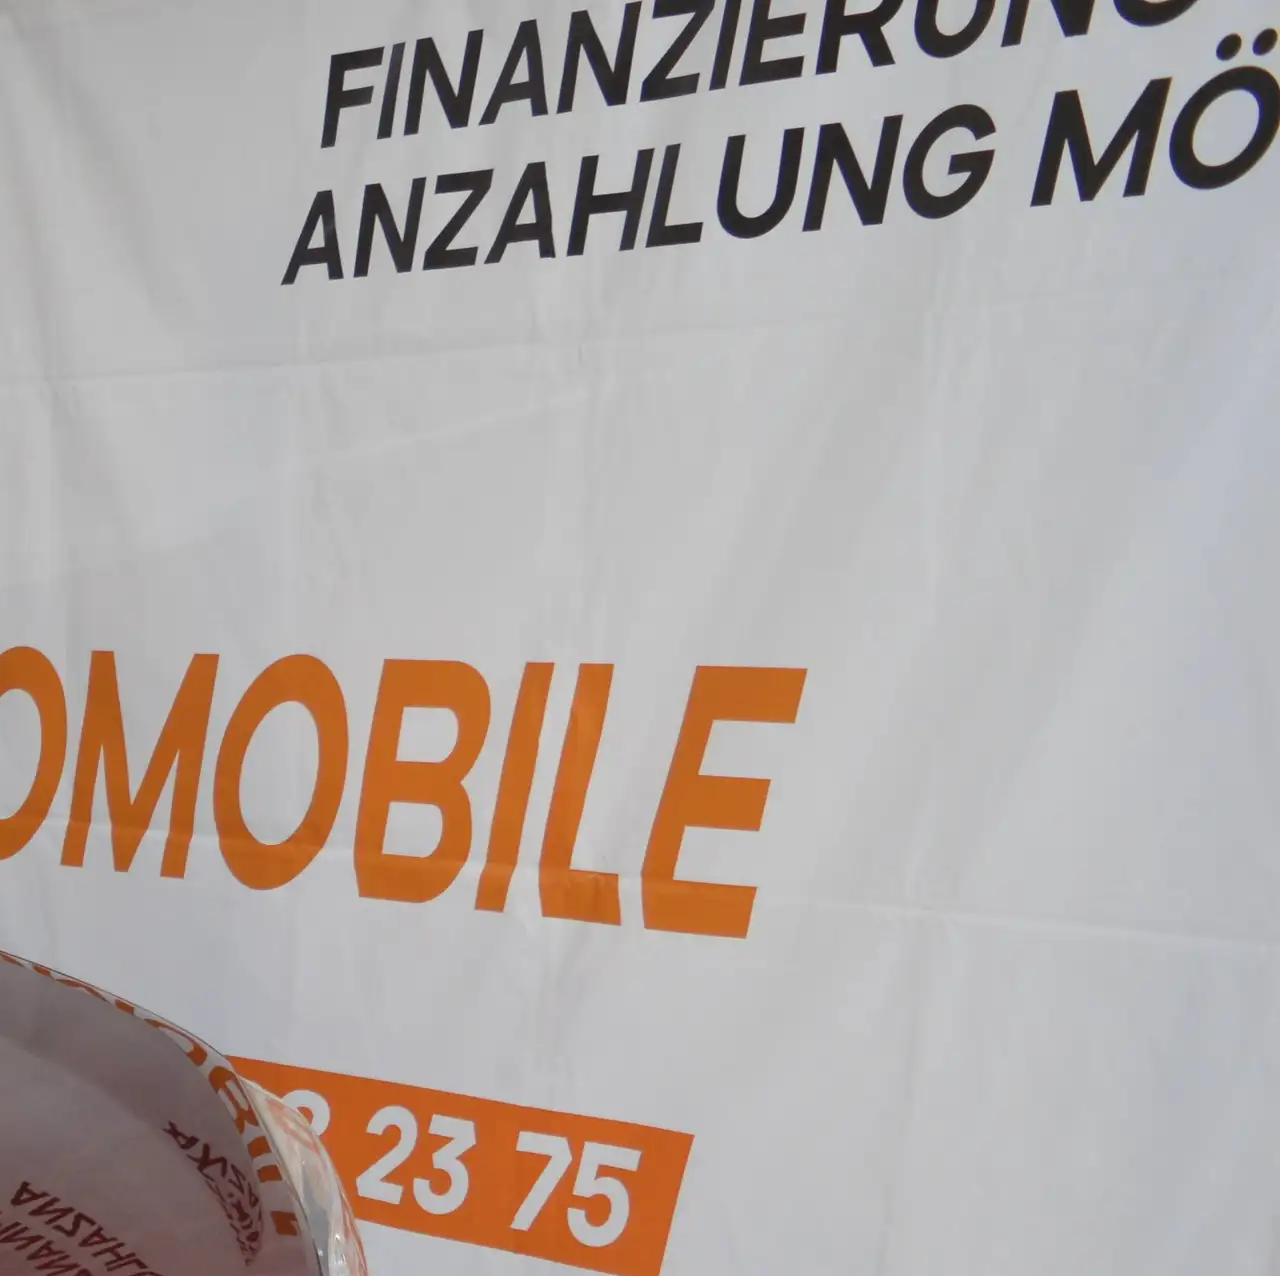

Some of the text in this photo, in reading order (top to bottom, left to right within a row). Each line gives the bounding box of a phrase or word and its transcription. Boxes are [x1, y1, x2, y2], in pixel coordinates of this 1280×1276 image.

[280, 27, 1280, 286] ANZAHLUNG MÖ
[355, 1104, 478, 1216] 23
[510, 1130, 643, 1248] 75
